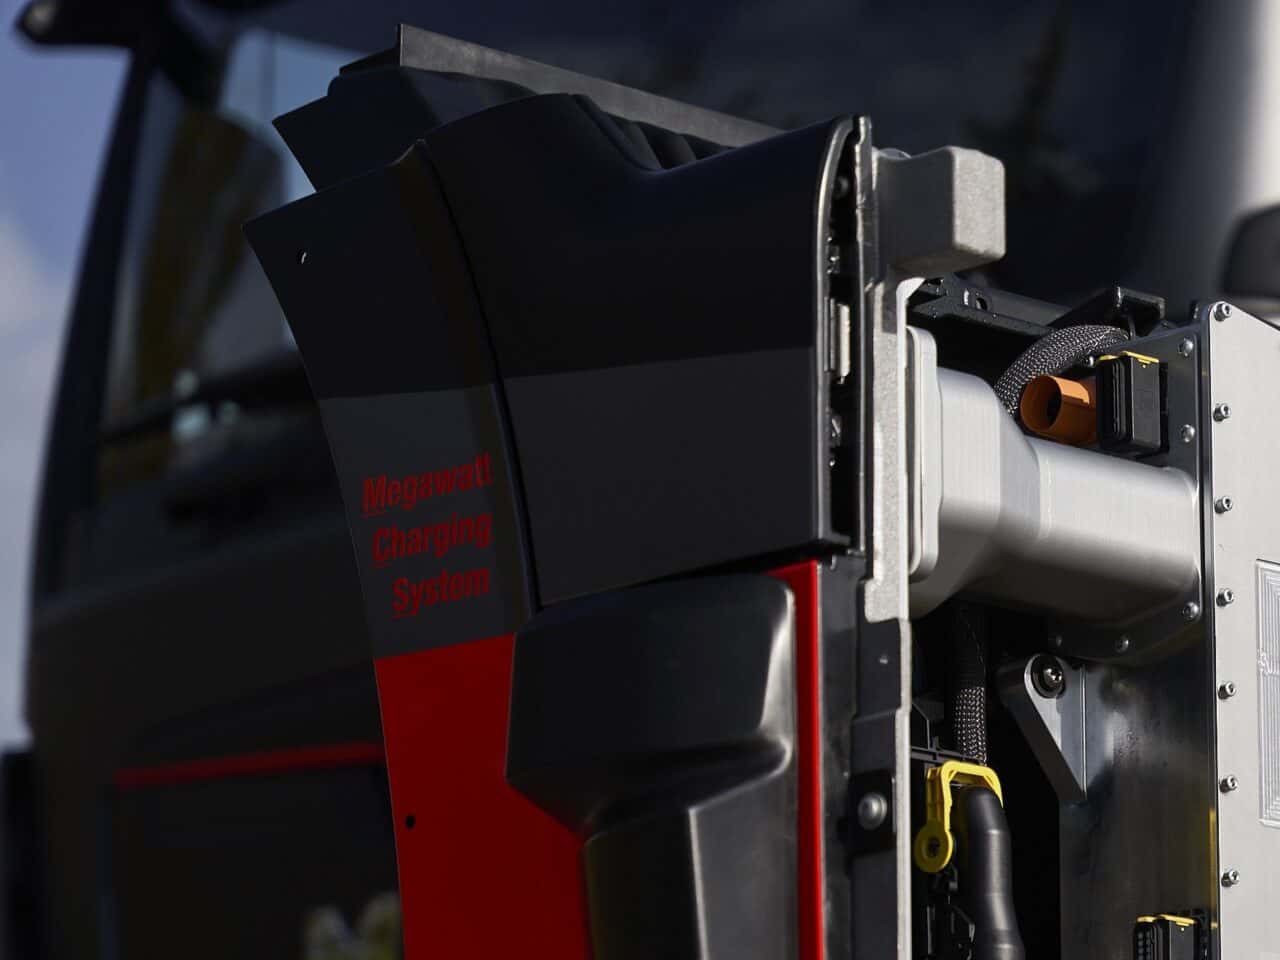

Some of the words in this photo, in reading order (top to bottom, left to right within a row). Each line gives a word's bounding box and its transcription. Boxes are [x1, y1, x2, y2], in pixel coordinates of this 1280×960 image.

[362, 452, 494, 514] Megawatt
[371, 512, 493, 564] Charging
[391, 566, 492, 616] System
